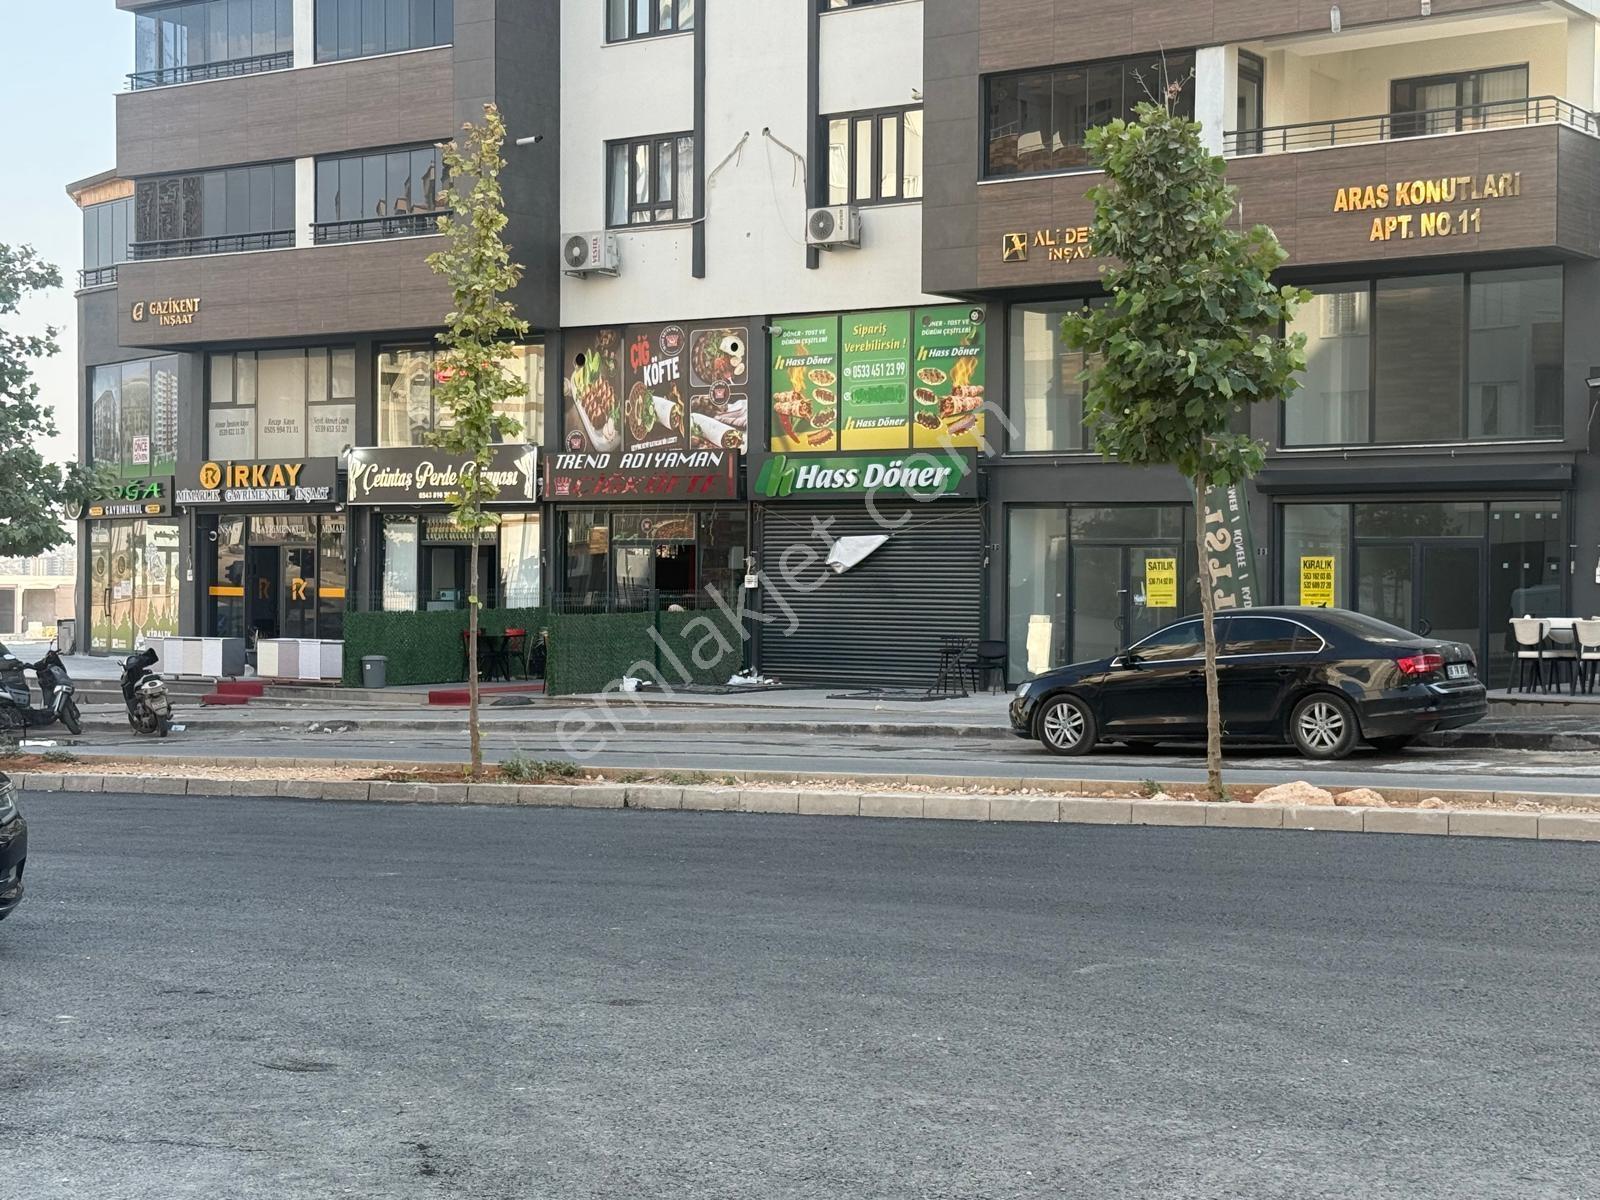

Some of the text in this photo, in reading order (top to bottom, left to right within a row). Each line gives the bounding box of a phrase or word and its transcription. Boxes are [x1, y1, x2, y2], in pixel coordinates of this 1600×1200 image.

[1333, 184, 1389, 212] ARAS
[1369, 208, 1482, 241] APT. NO.11
[149, 298, 201, 315] GAZİKENT
[852, 322, 888, 338] Sipariş
[844, 338, 900, 353] Verebilirsin
[928, 348, 950, 358] Hass
[951, 346, 980, 357] Döner
[785, 358, 806, 367] Hass
[806, 355, 833, 365] Döner
[643, 356, 680, 387] KÖFTE
[852, 361, 906, 379] 0533 451 23 99
[855, 419, 877, 429] Hass
[877, 416, 906, 427] Döner
[555, 452, 724, 469] TREND ADIYAMAN
[226, 461, 303, 488] İRKAY
[363, 463, 413, 495] Çetintaş
[416, 461, 458, 489] Perde
[795, 465, 860, 489] Hass
[862, 459, 952, 488] Döner
[1148, 561, 1174, 571] SATILIK
[1303, 560, 1333, 570] KİRALIK
